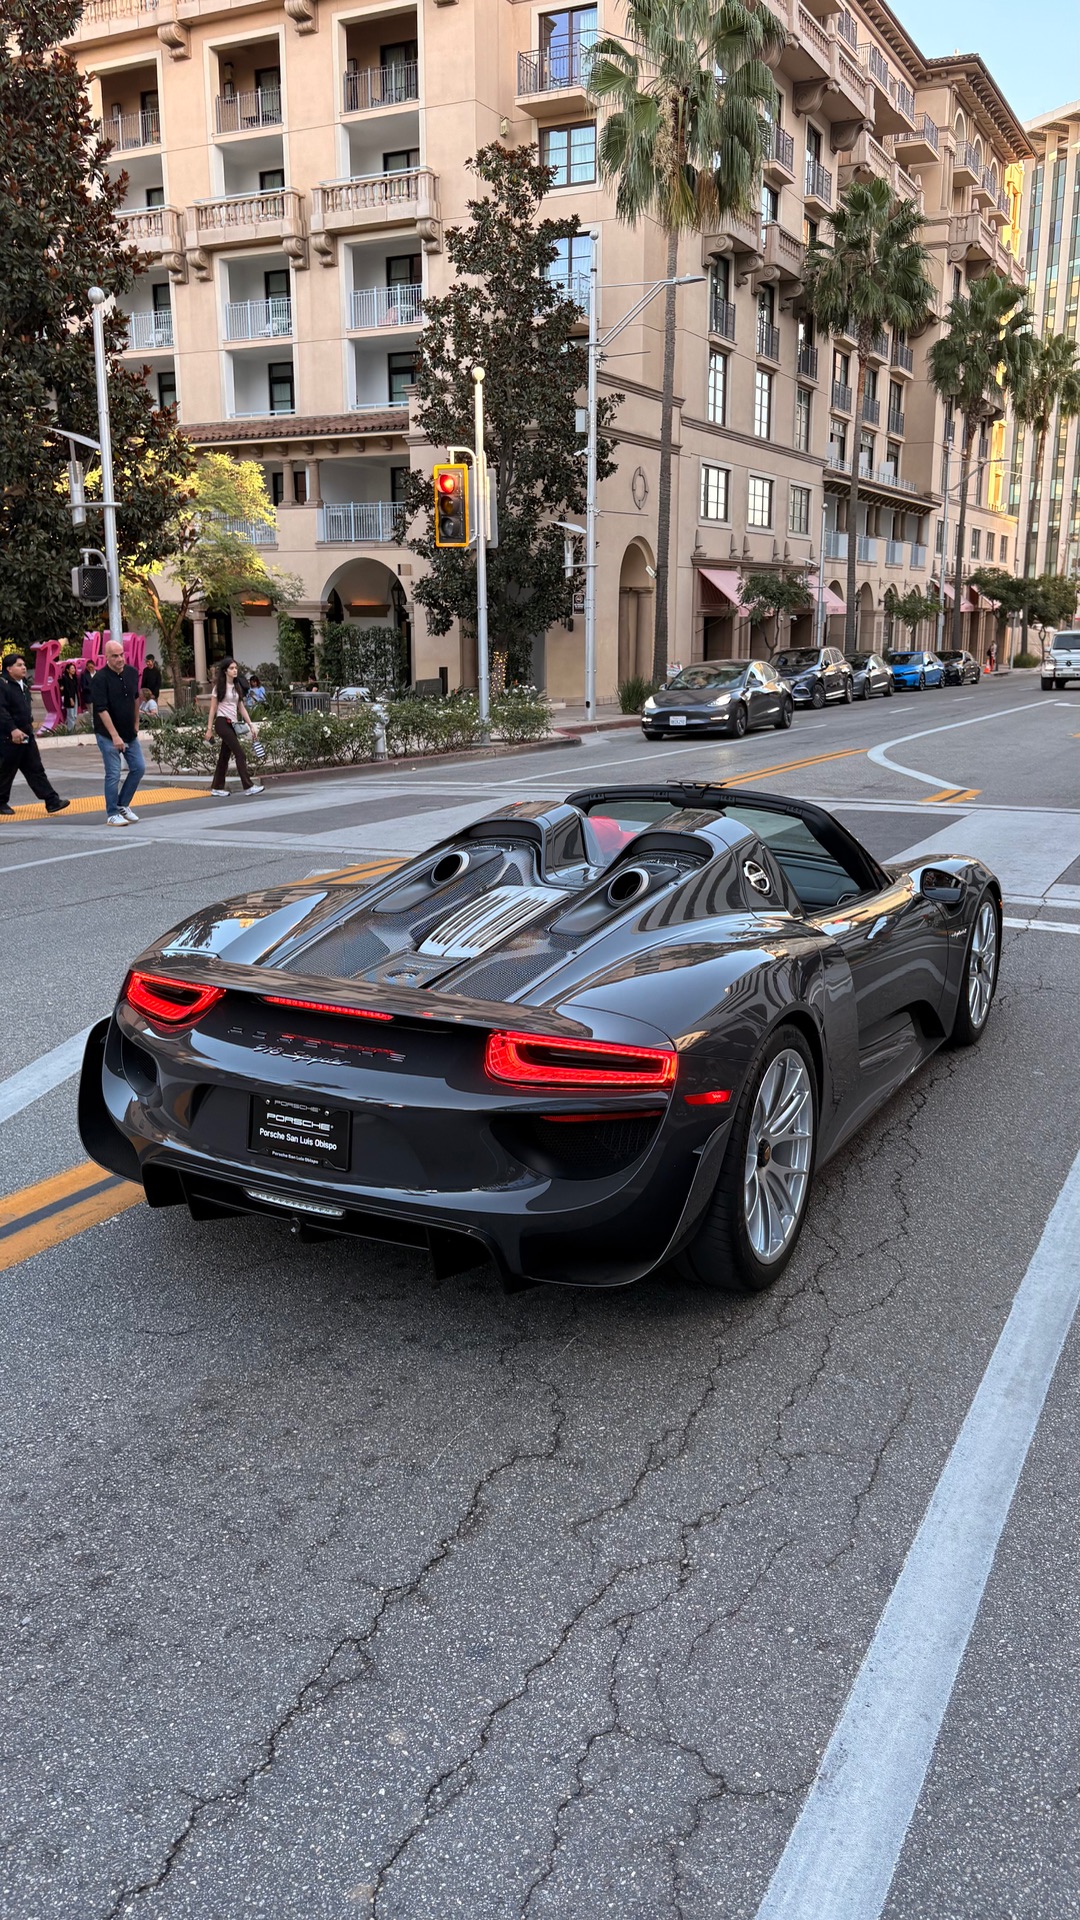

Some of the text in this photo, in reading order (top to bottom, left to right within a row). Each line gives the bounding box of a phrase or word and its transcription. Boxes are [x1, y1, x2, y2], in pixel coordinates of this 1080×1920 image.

[253, 1043, 284, 1055] 918
[274, 1100, 319, 1113] PORSCHE
[266, 1112, 331, 1131] PORSCHE
[259, 1128, 337, 1151] Porsche San Luis Obispo
[271, 1150, 288, 1158] Porsche
[304, 1157, 319, 1165] Obispo
